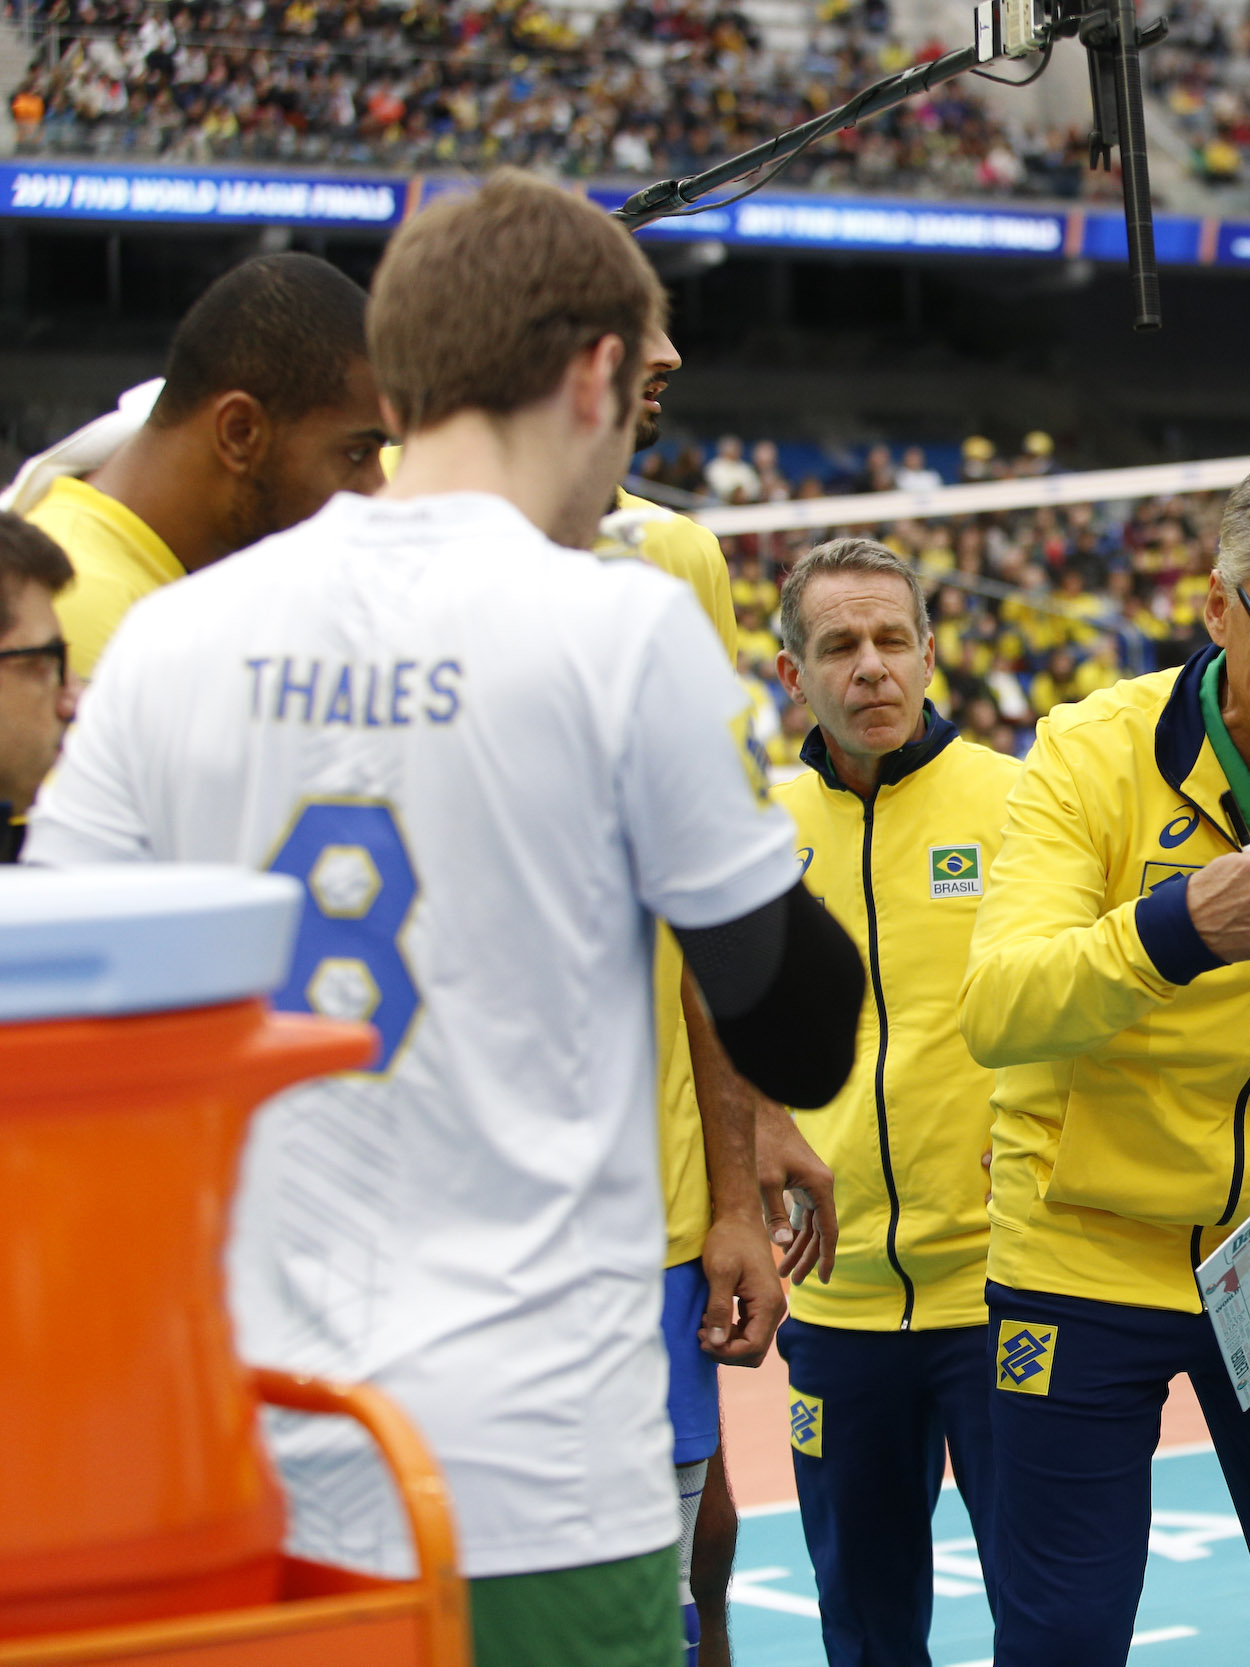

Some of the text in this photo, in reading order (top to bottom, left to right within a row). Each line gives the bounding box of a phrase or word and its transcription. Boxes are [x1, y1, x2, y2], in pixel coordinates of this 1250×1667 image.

[12, 173, 72, 208] 2017
[245, 656, 464, 728] THALES
[933, 881, 979, 895] BRASIL
[262, 794, 426, 1083] 8
